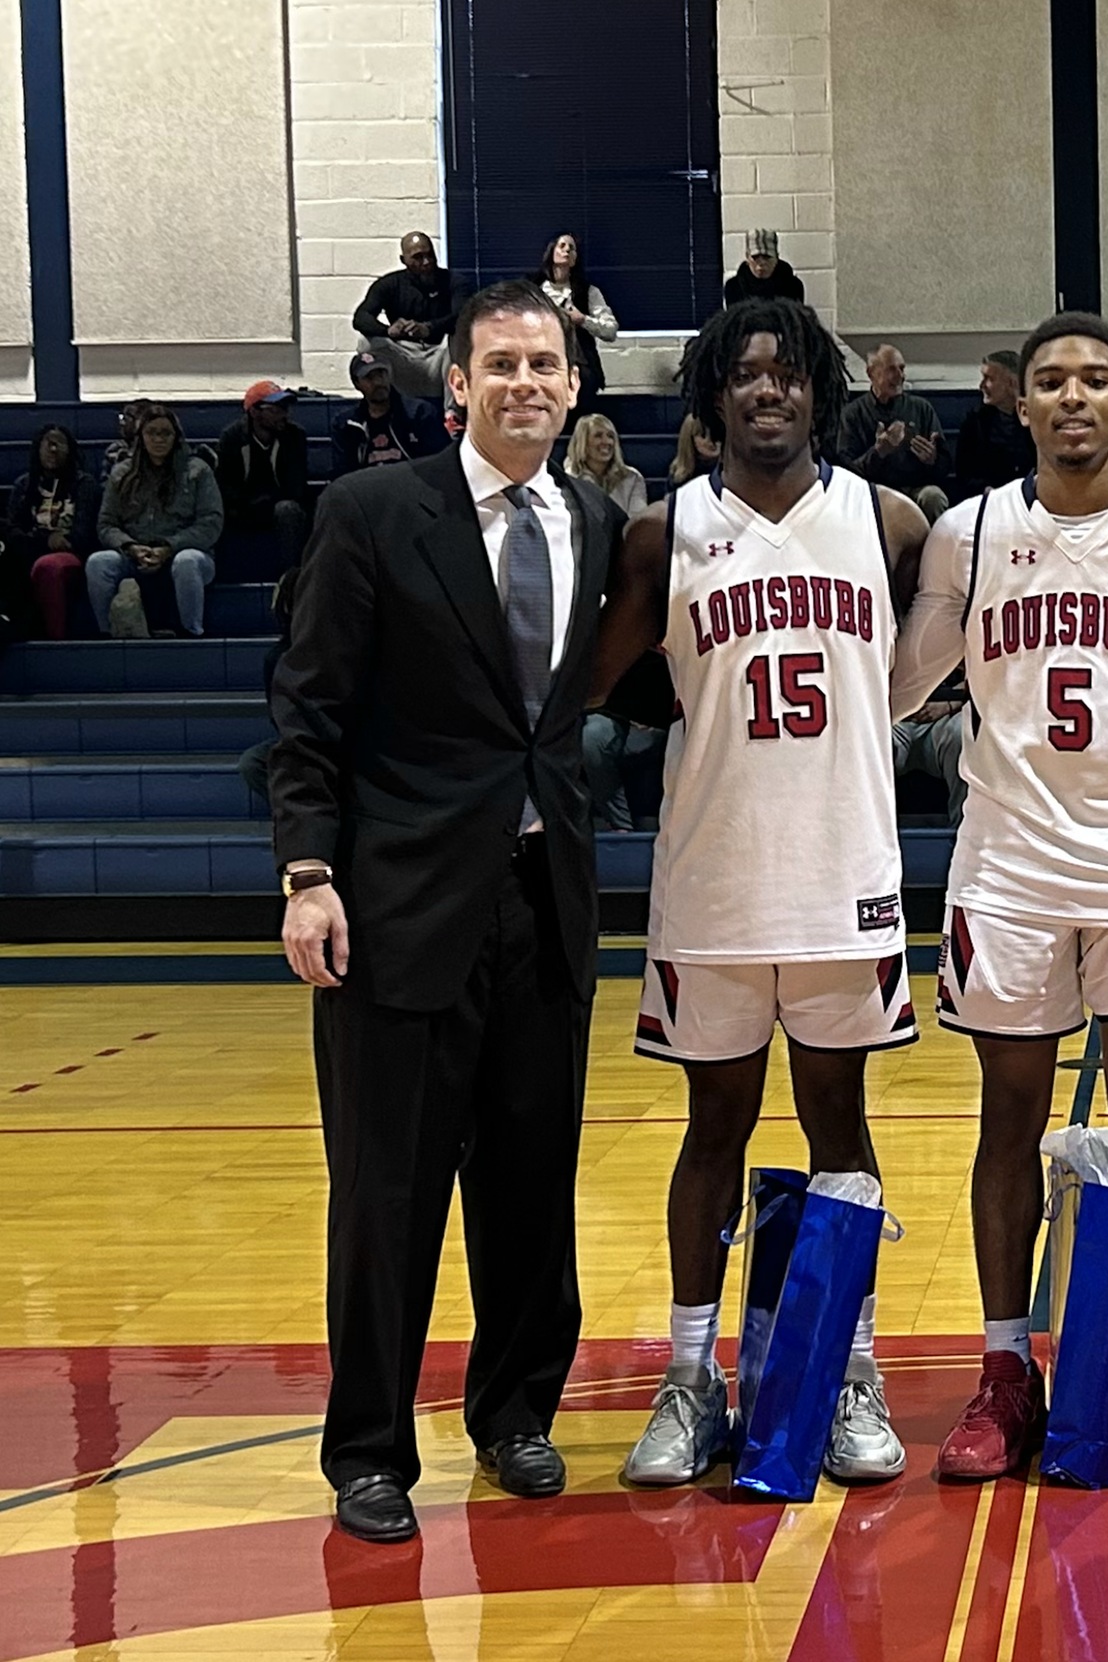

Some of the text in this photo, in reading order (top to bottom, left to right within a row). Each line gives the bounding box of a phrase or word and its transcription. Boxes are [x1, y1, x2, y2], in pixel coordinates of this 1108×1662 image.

[689, 576, 872, 657] LOUISBURG
[746, 653, 827, 740] 15
[1048, 668, 1092, 752] 5
